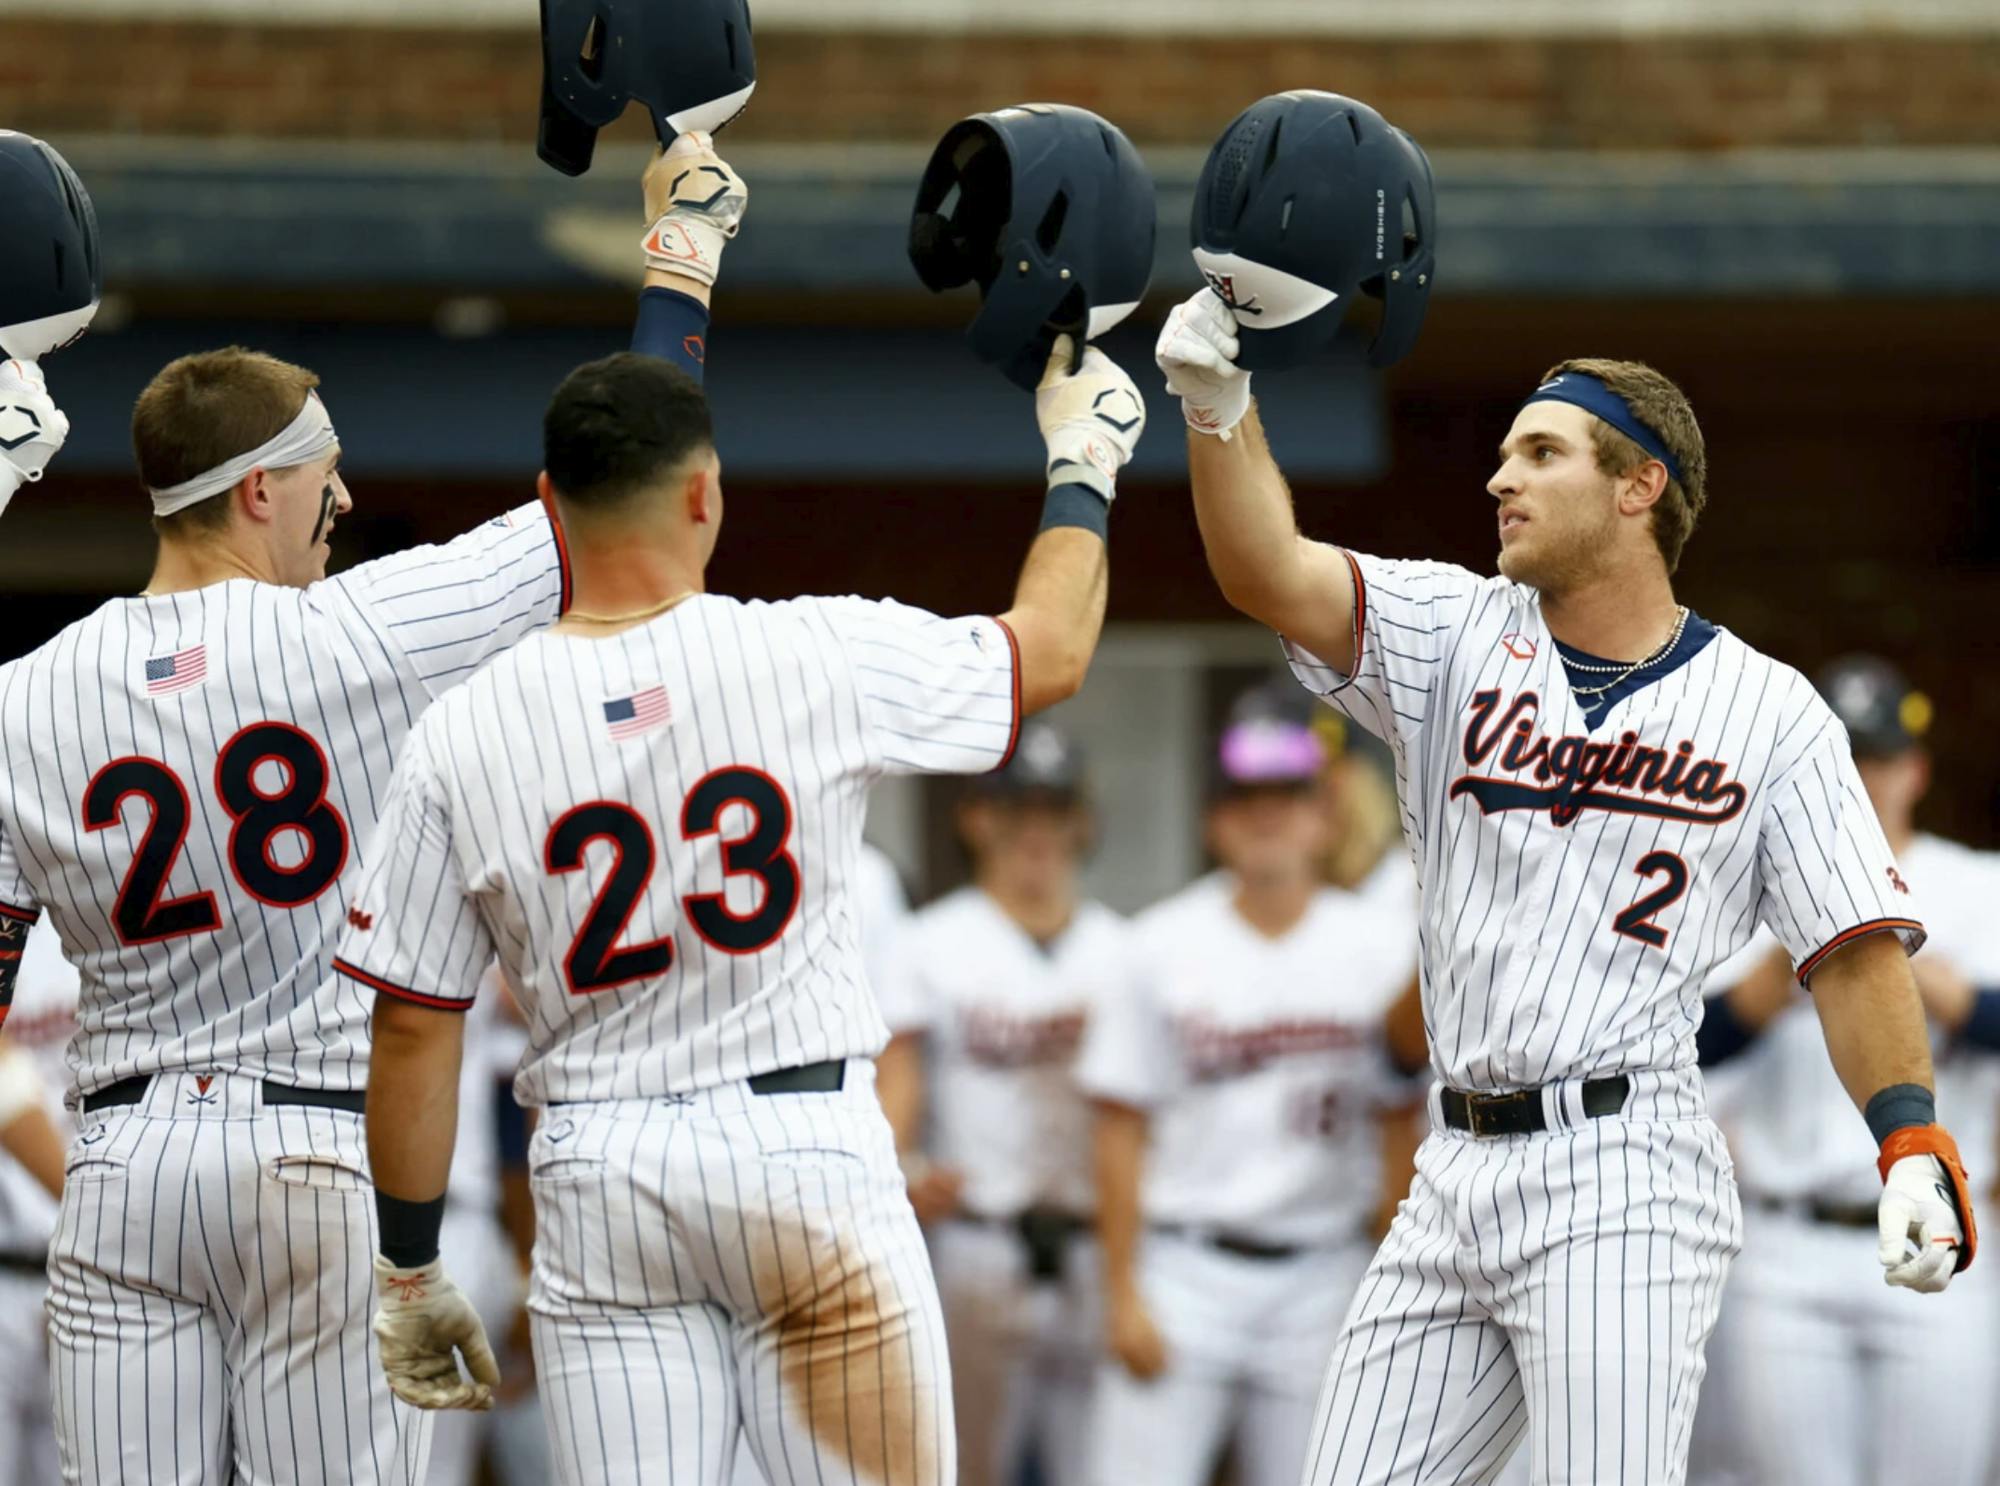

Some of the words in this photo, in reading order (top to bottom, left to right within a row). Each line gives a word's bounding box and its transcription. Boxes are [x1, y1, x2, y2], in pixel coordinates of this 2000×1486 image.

[1376, 189, 1385, 259] EVOSHIELD
[82, 721, 349, 947] 28
[544, 764, 801, 996] 23
[1611, 850, 1688, 949] 2
